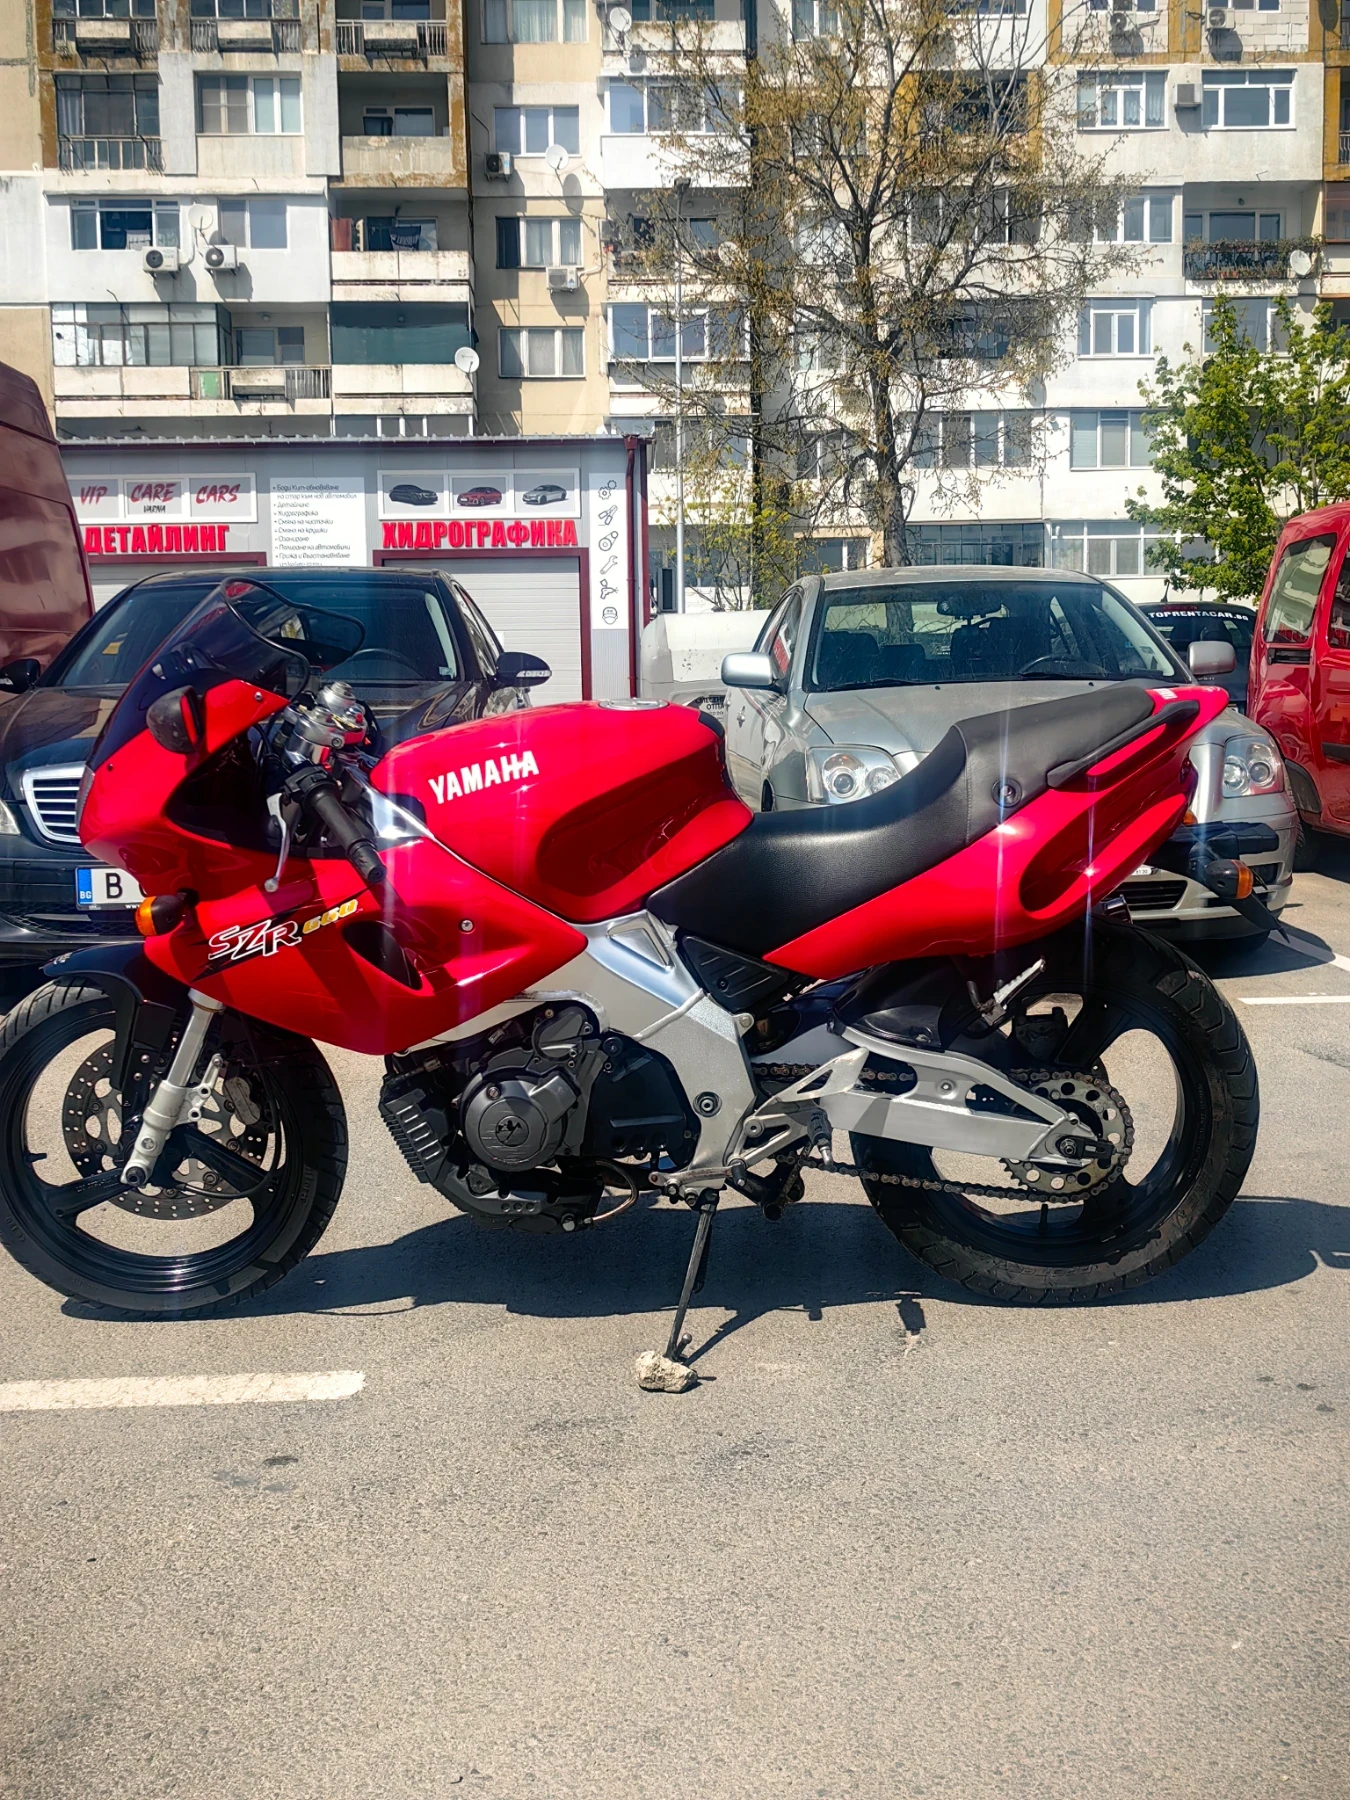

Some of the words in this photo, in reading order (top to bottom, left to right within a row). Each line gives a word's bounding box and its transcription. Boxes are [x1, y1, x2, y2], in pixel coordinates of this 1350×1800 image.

[80, 485, 108, 506] VIP
[130, 483, 178, 504] CARE
[195, 483, 241, 505] CARS
[143, 504, 167, 514] VARNA
[84, 524, 230, 554] ДЕТАЙЛИНГ
[381, 519, 579, 550] ХИДРОГРАФИКА
[1148, 610, 1249, 621] TOPRENTACAR.BG
[428, 750, 540, 805] YAMAHA
[79, 890, 92, 899] BG
[105, 872, 123, 899] B
[207, 919, 302, 961] SZR
[302, 899, 359, 934] 660
